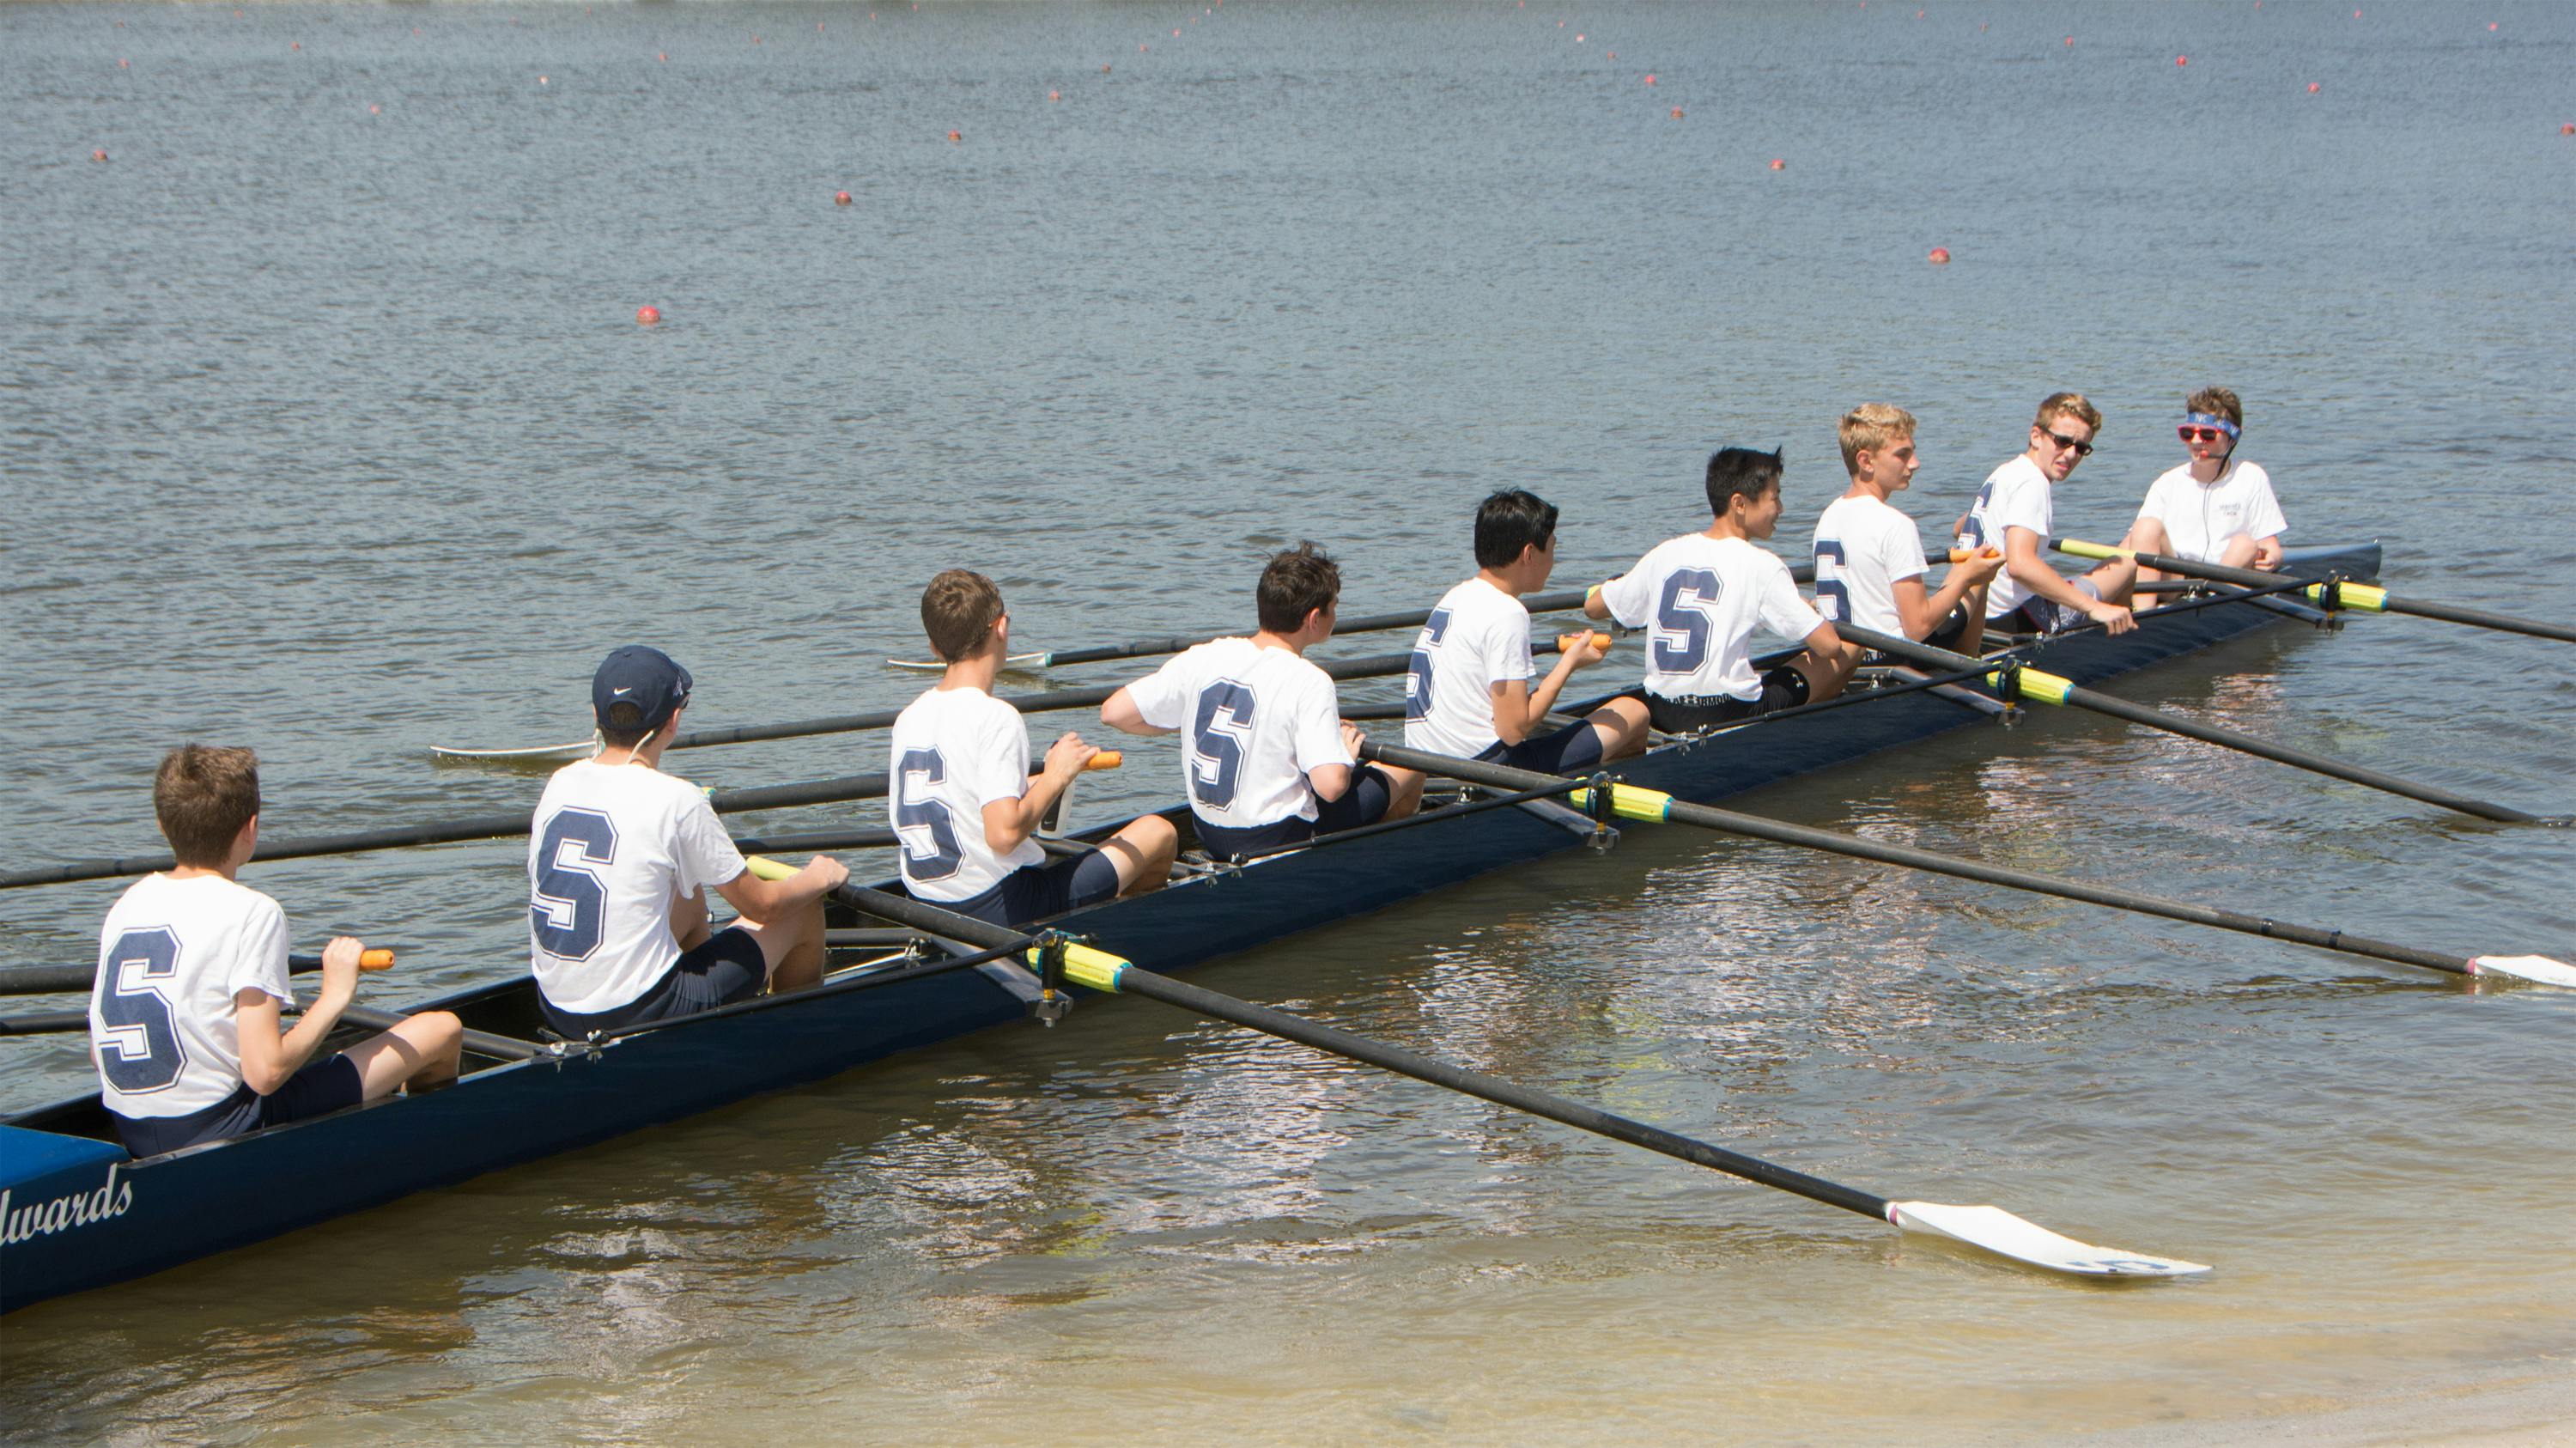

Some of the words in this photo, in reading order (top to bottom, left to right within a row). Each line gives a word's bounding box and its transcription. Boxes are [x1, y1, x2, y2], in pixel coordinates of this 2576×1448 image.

[1651, 565, 1724, 676] S
[1813, 537, 1854, 626] S
[1406, 606, 1454, 724] S
[1189, 675, 1259, 813] S
[890, 743, 968, 885] S
[528, 804, 620, 964] S
[98, 923, 189, 1096] S
